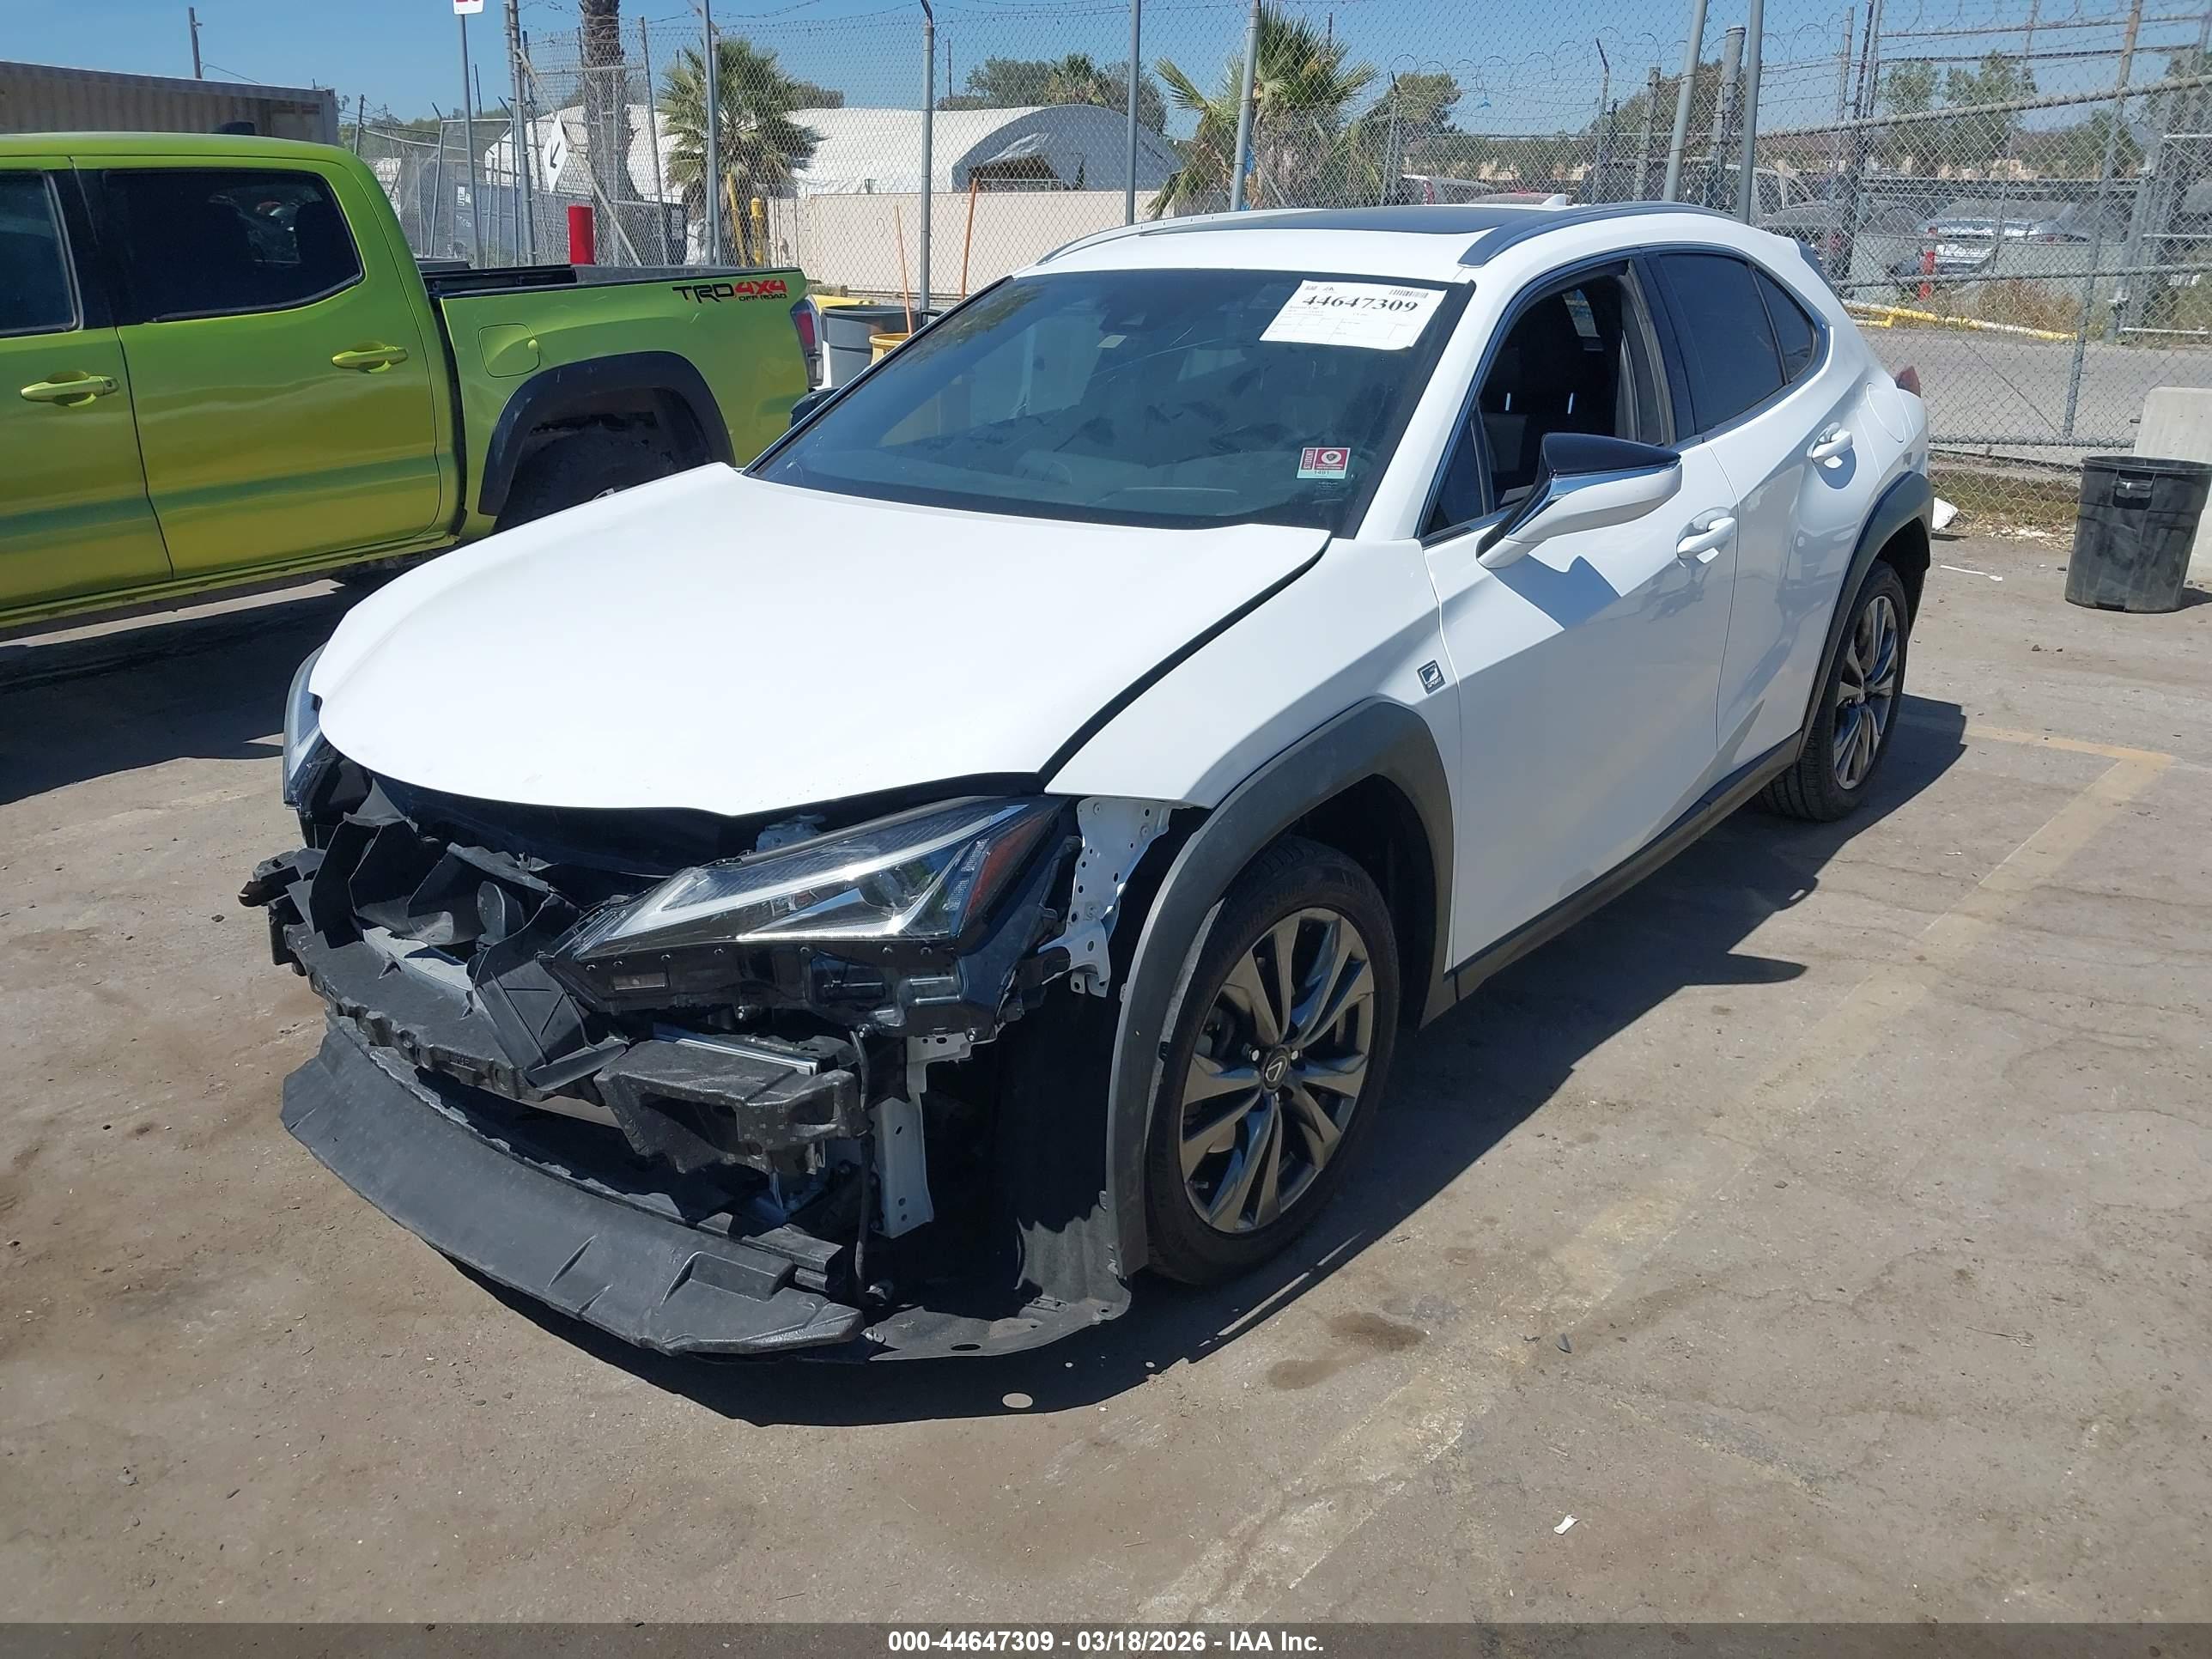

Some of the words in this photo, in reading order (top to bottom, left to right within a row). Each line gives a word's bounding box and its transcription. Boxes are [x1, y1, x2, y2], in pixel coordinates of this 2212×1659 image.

[672, 283, 735, 304] TRD
[760, 293, 787, 301] ROAD
[1303, 294, 1419, 313] 44647309
